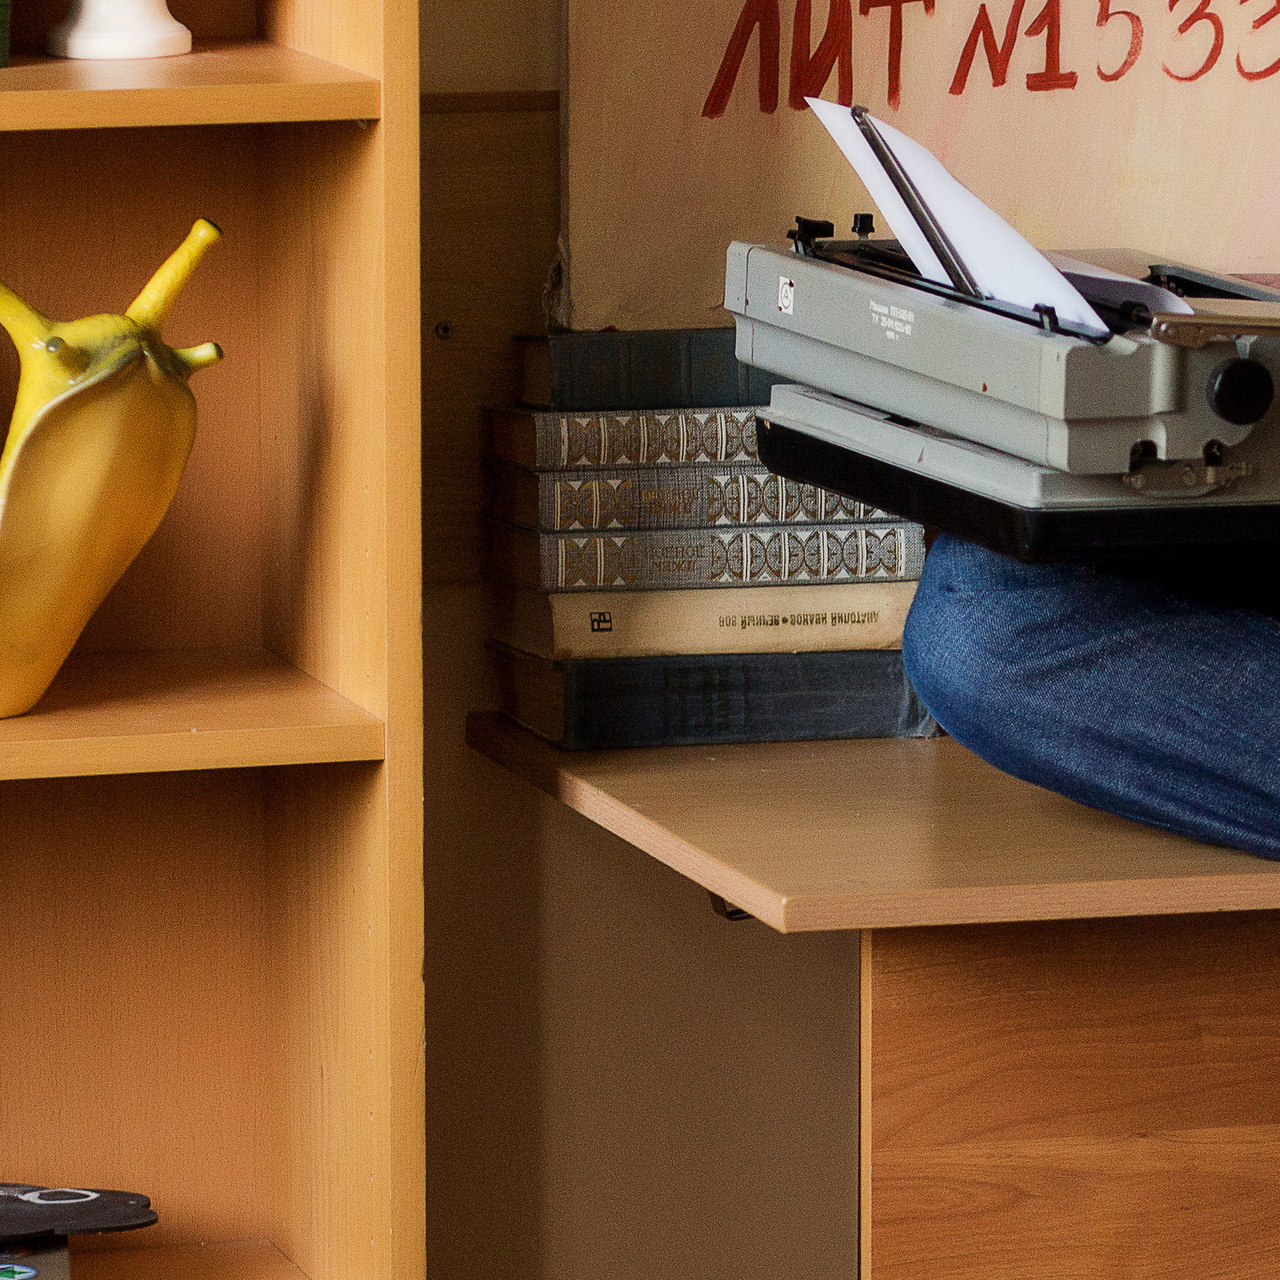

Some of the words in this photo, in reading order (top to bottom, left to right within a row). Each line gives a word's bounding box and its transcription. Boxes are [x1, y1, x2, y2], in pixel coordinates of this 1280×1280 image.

[740, 615, 780, 629] ВЕЧНЫЙ
[789, 613, 828, 627] ИВАНОВ
[830, 611, 879, 627] АНАТОЛИЙ
